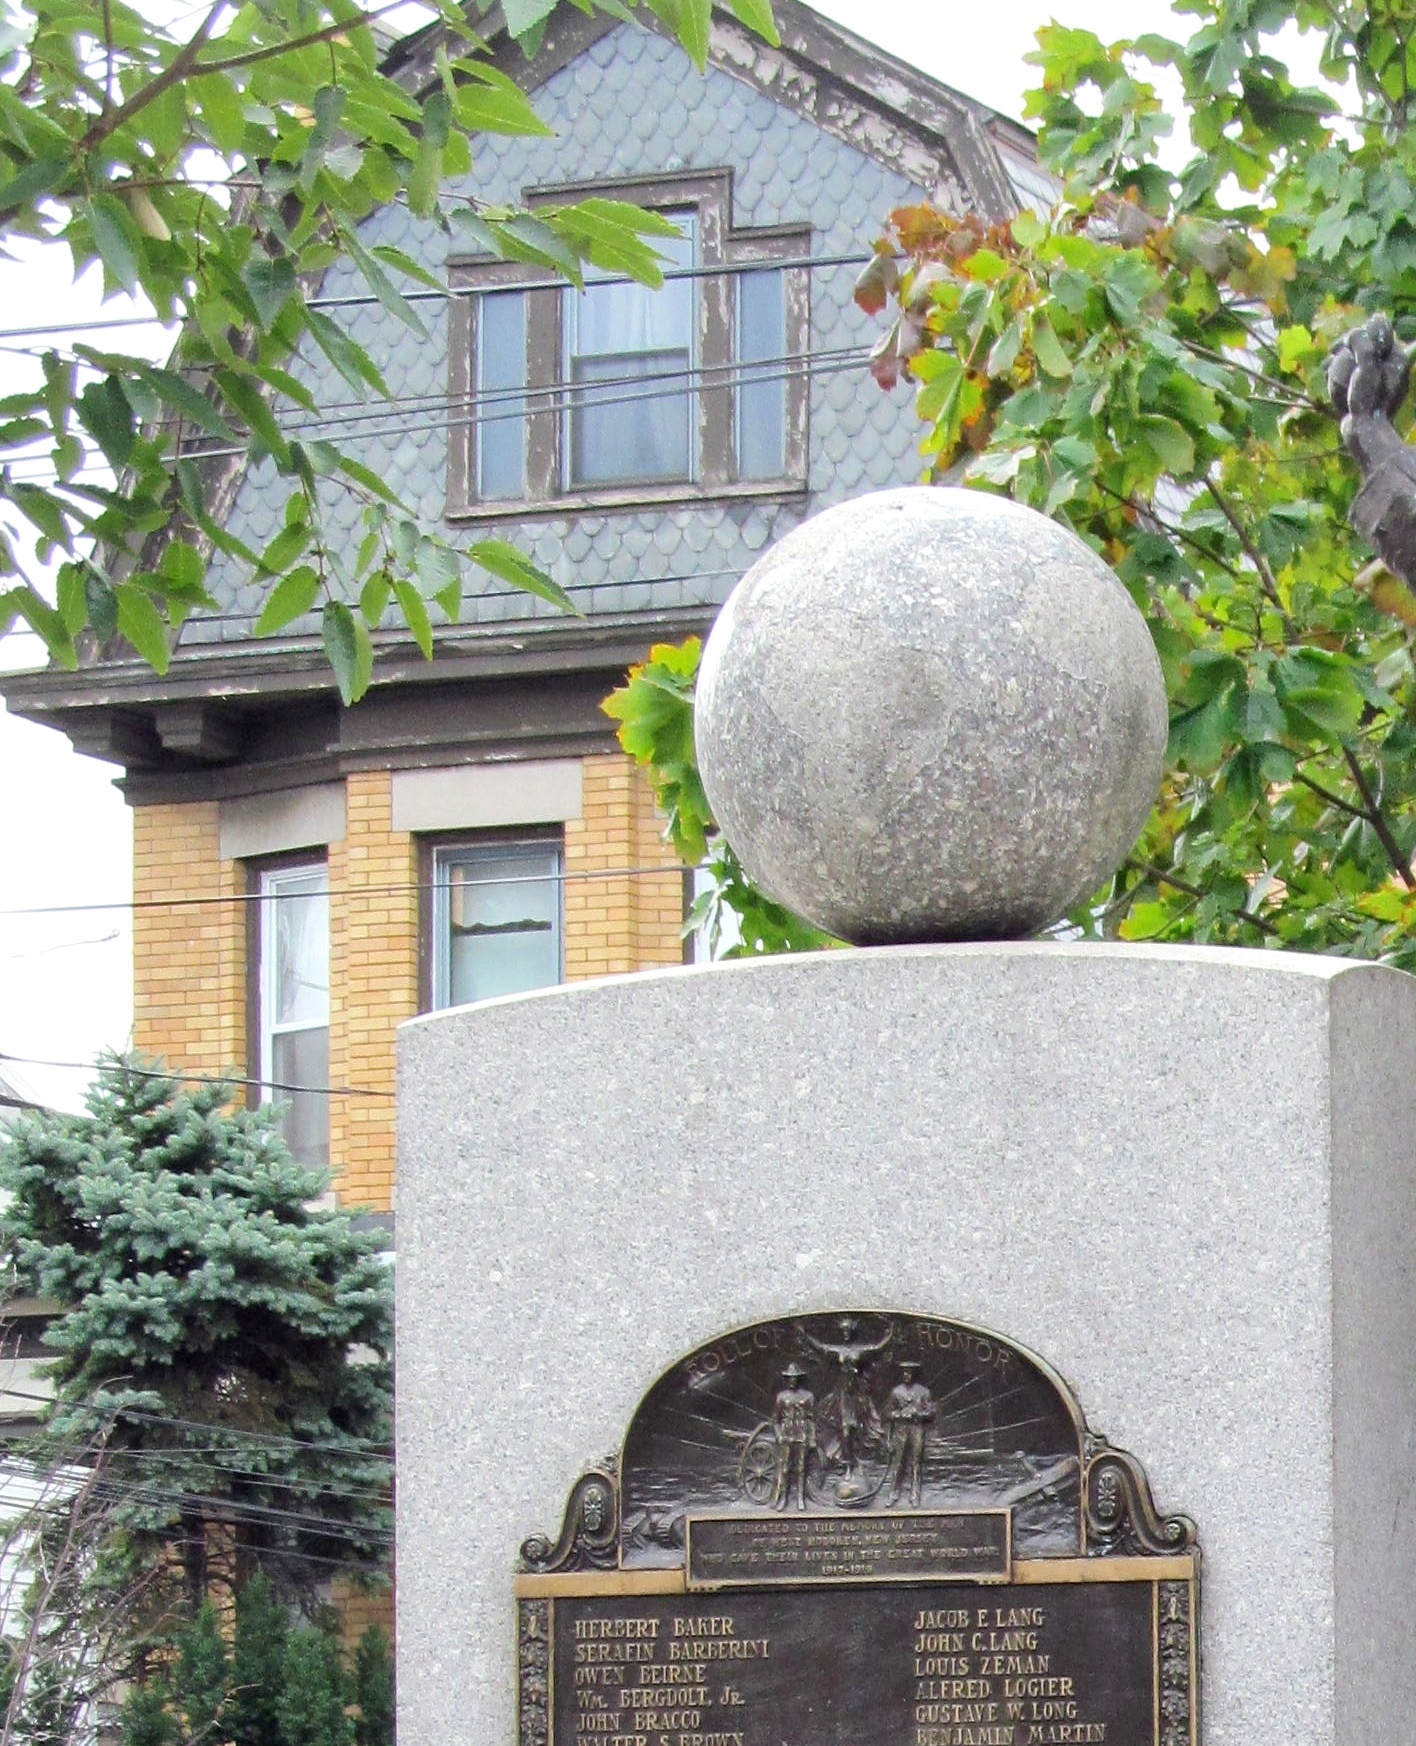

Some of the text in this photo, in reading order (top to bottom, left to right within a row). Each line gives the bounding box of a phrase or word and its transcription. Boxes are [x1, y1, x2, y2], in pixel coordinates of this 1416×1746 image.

[576, 1617, 733, 1638] HERBERT BAKER
[915, 1632, 1038, 1652] JOHN C. LANG
[915, 1656, 1050, 1676] LOUIS ZEMAN
[915, 1679, 1073, 1699] ALFRED LOGIER
[577, 1712, 700, 1731] JOHN BRACCO
[916, 1702, 1078, 1723] GUSTAVE W. LONG
